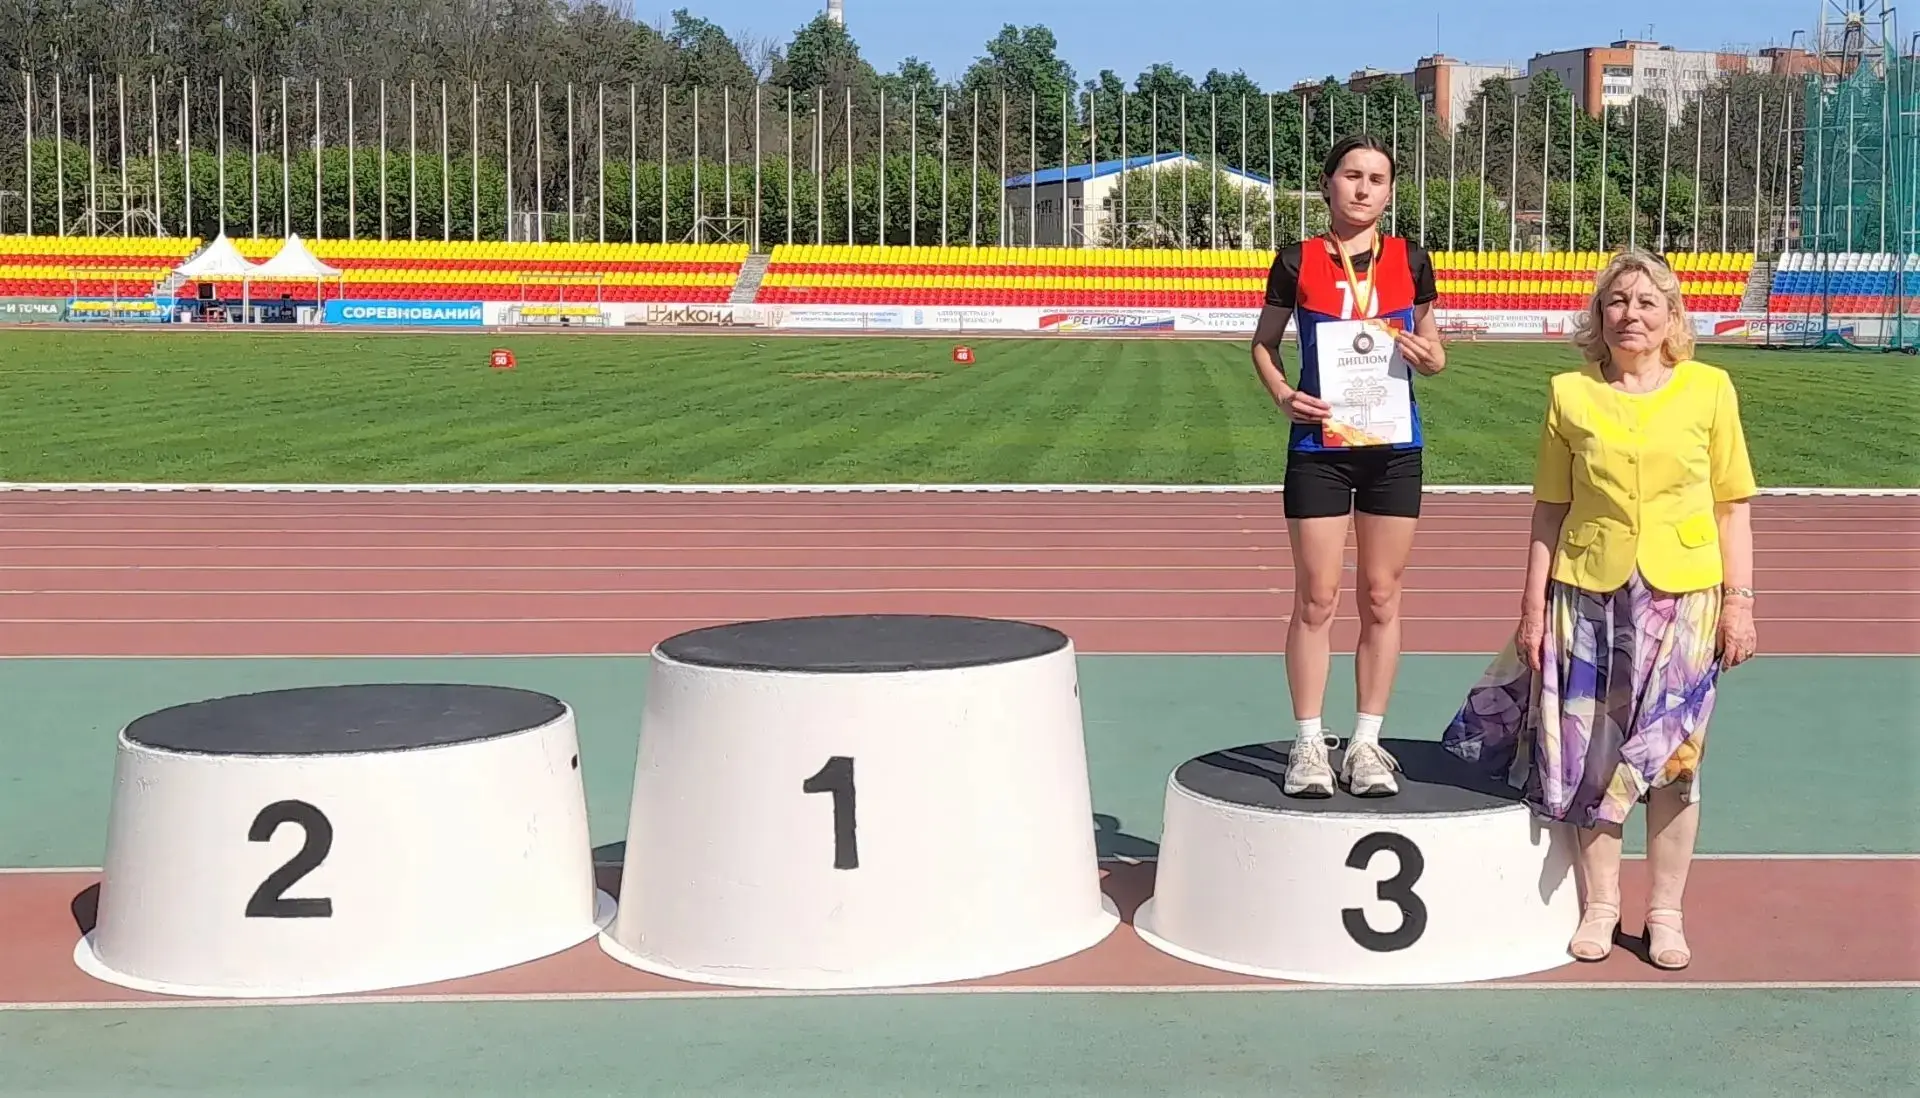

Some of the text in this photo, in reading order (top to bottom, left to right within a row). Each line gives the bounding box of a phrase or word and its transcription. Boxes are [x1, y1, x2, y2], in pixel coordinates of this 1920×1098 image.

[18, 303, 58, 313] ТОЧКА
[343, 305, 481, 320] СОРЕВНОВАНИЙ
[1337, 355, 1388, 368] ДИПЛОМ
[803, 756, 859, 870] 1
[246, 799, 333, 918] 2
[1341, 831, 1428, 953] 3
